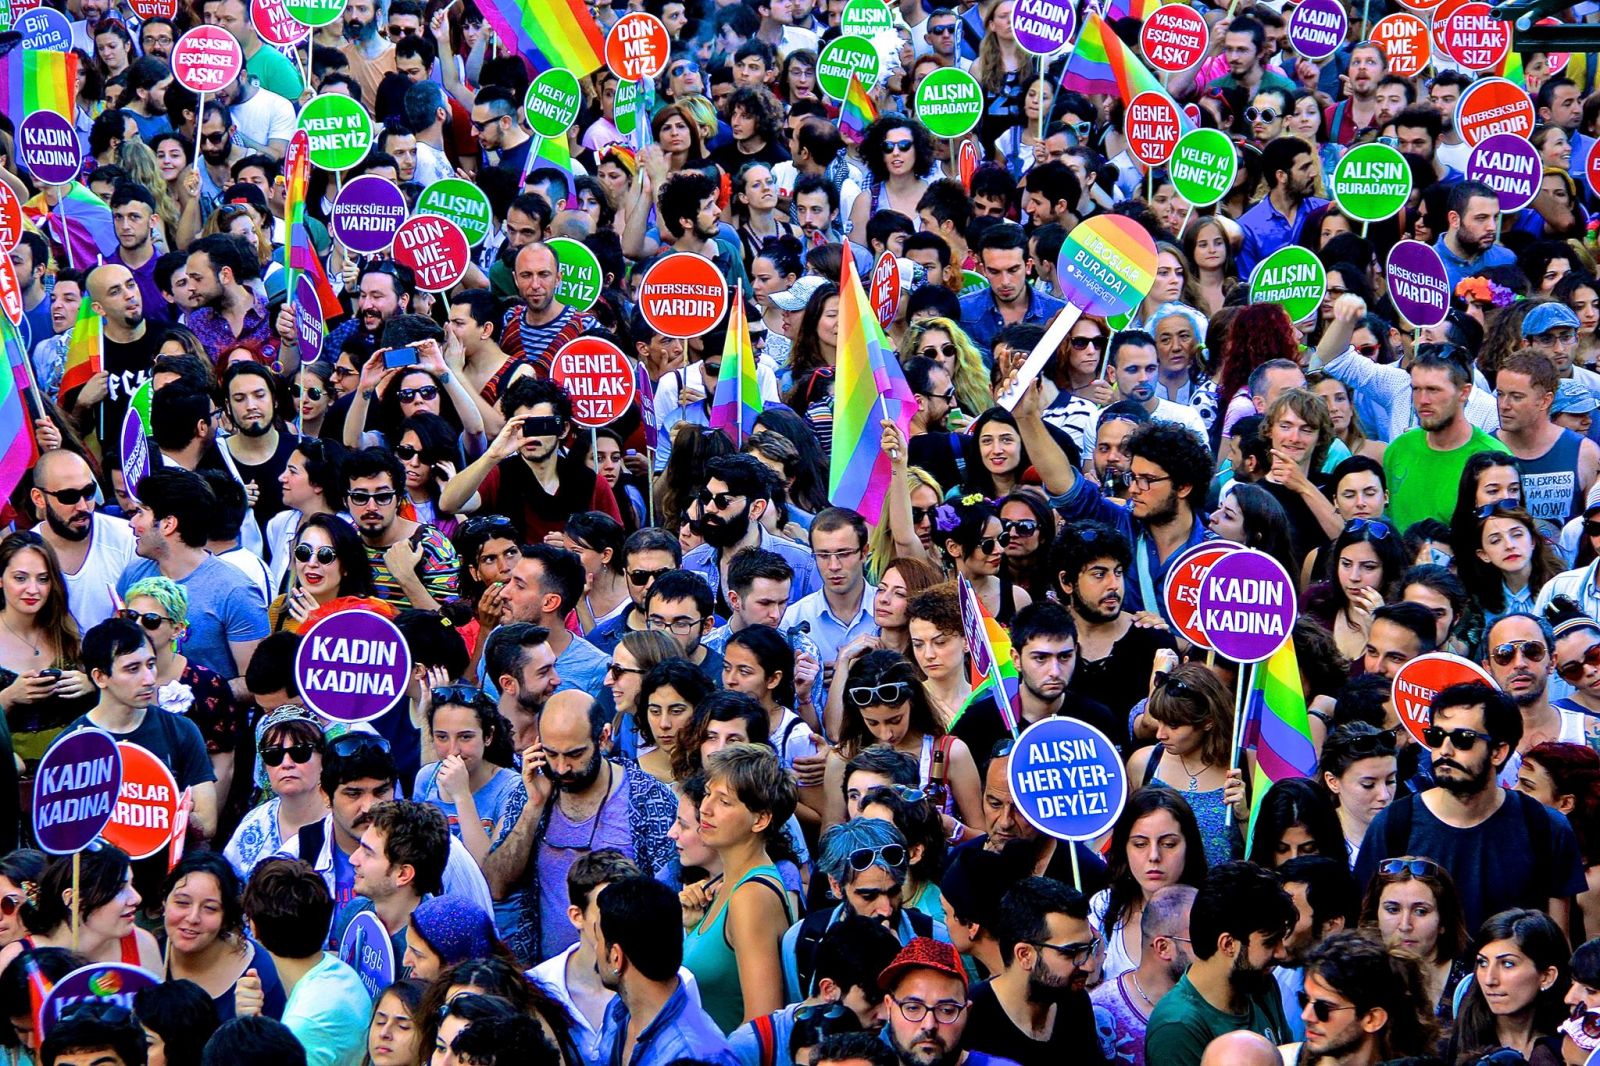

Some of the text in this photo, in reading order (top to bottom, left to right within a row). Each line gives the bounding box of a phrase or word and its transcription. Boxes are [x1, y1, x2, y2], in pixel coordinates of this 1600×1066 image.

[847, 8, 886, 25] ALIŞIN
[1020, 0, 1070, 25] KADIN
[1155, 13, 1201, 32] YAŞASIN
[1297, 7, 1341, 29] KADIN
[618, 19, 658, 42] DÖN-
[1015, 15, 1064, 44] KADINA
[1292, 26, 1337, 46] KADINA
[1382, 19, 1424, 38] DÖN-
[22, 30, 61, 50] evîna
[184, 37, 234, 51] YAŞASIN
[624, 39, 656, 57] ME-
[1146, 28, 1200, 50] EŞCİNSEL
[1387, 39, 1418, 55] ME-
[1452, 32, 1505, 48] AHLAK-
[179, 50, 234, 67] EŞCİNSEL
[623, 57, 656, 76] YİZ!
[826, 48, 876, 70] ALIŞIN
[1152, 48, 1189, 65] AŞK!
[1463, 50, 1491, 65] SIZ!
[186, 67, 224, 85] AŞK!
[538, 82, 575, 107] VELEV Kİ
[923, 83, 974, 102] ALIŞIN
[527, 93, 573, 126] İBNEYİZ
[919, 101, 980, 115] BURADAYIZ
[1132, 104, 1173, 123] GENEL
[304, 113, 361, 131] VELEV Kİ
[1132, 123, 1177, 141] AHLAK-
[25, 128, 72, 147] KADIN
[309, 131, 368, 151] BNEYİZ
[27, 150, 77, 167] KADINA
[1141, 142, 1164, 160] SIZ!
[1181, 146, 1230, 171] VELEV Kİ
[1343, 162, 1402, 181] ALIŞIN
[1475, 149, 1534, 175] KADIN
[1173, 164, 1228, 192] İBNEYİZ
[1337, 183, 1407, 196] BURADAYIZ
[335, 203, 403, 215] BİSEKSÜELLER
[427, 191, 485, 217] ALIŞIN
[341, 216, 395, 231] VARDIR
[399, 220, 450, 249] DÖN-
[413, 242, 450, 267] ME-
[417, 260, 458, 286] YİZ!
[578, 266, 592, 280] Kİ
[877, 258, 896, 286] DÖN-
[1074, 250, 1127, 295] BURADA!
[1260, 264, 1316, 286] ALIŞIN
[1388, 263, 1448, 294] BİSEKSÜELLER
[644, 282, 721, 296] İNTERSEKSLER
[878, 281, 893, 305] ME-
[1394, 280, 1444, 310] VARDIR
[649, 299, 715, 318] VARDIR
[560, 354, 622, 374] GENEL
[563, 377, 630, 396] AHLAK-
[577, 400, 613, 418] SIZ!
[1538, 475, 1572, 486] EXPRESS
[1556, 489, 1571, 498] YOU
[1532, 502, 1565, 516] NOW!
[1209, 576, 1284, 606] KADIN
[1206, 608, 1284, 636] KADINA
[312, 635, 397, 666] KADIN
[305, 668, 395, 696] KADINA
[1029, 738, 1097, 765] ALIŞIN
[42, 755, 114, 796] KADIN
[1017, 765, 1115, 793] HER YER-
[38, 791, 110, 830] KADINA
[1036, 788, 1109, 819] DEYİZ!
[110, 802, 169, 829] ARDIR
